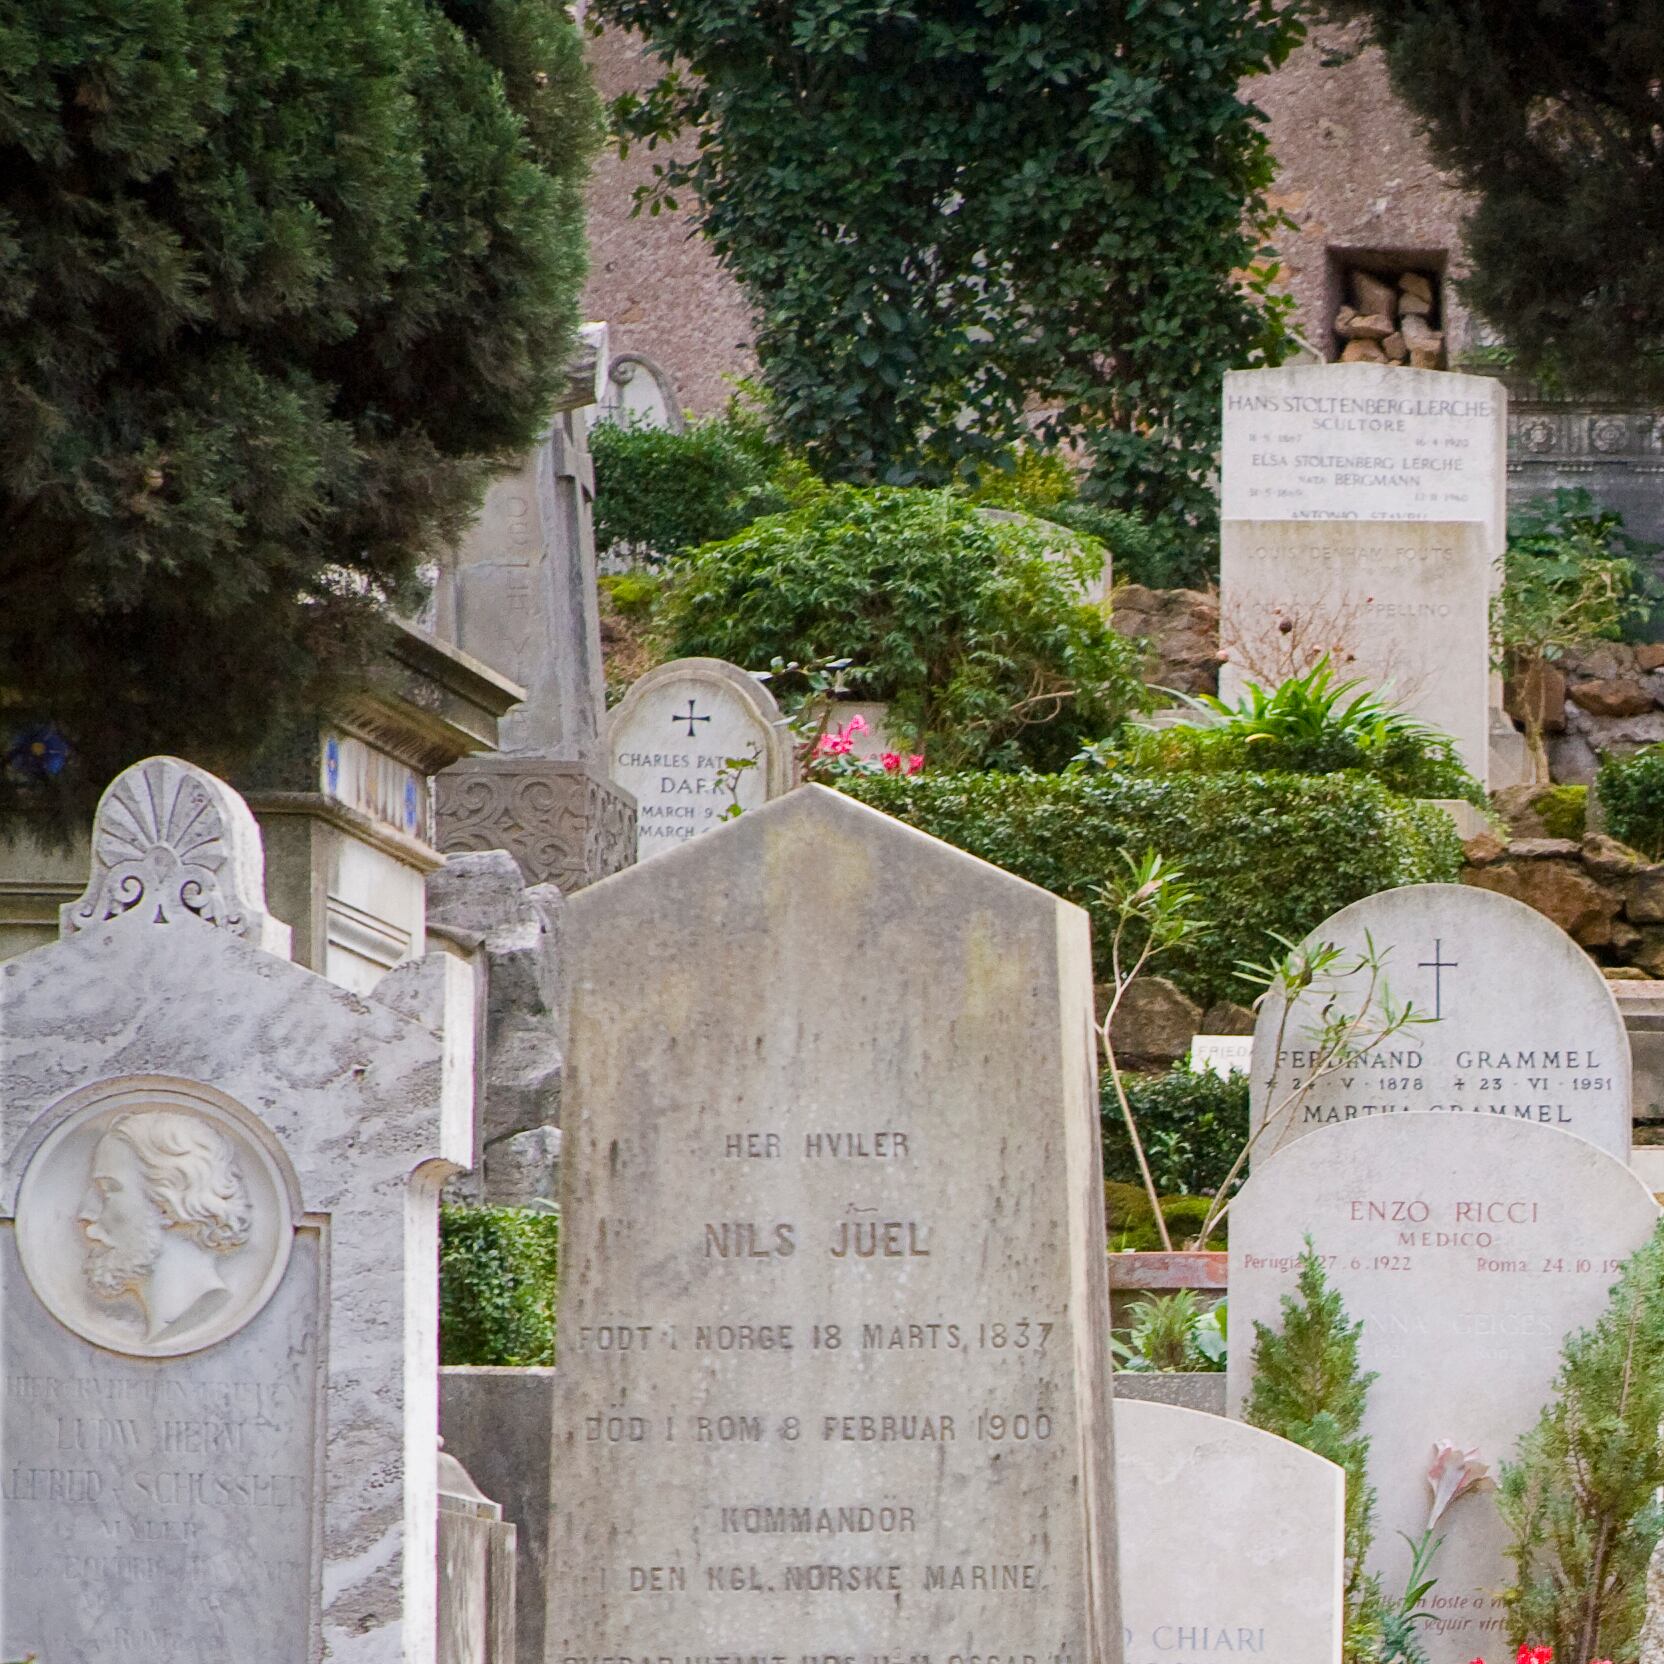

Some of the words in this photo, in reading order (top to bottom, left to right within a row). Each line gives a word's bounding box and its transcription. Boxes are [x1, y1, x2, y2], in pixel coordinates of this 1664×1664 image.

[1228, 395, 1279, 413] HANS
[1284, 396, 1414, 416] STOLTENBERG
[1416, 400, 1491, 418] LERCHE
[1313, 418, 1406, 432] SCULTORE
[1252, 454, 1288, 468] ELSA
[1294, 455, 1394, 470] STOLTENBERG
[1402, 457, 1464, 472] LERCHE
[1334, 474, 1421, 487] BERGMANN
[618, 753, 690, 768] CHARLES
[641, 806, 695, 819] MARCH
[1456, 1050, 1601, 1069] GRAMMEL
[1379, 1077, 1424, 1091] 1878
[1530, 1077, 1549, 1091] VI
[1572, 1077, 1613, 1091] 1951
[726, 1133, 781, 1158] HER
[805, 1132, 910, 1158] HVILER
[1350, 1200, 1431, 1223] ENZO
[1455, 1201, 1539, 1225] RICCI
[703, 1222, 796, 1258] NILS
[830, 1222, 931, 1258] JUEL
[1398, 1231, 1493, 1248] MEDICO
[1243, 1254, 1305, 1277] Perugia
[1477, 1255, 1528, 1273] Roma
[695, 1324, 794, 1351] NORGE
[812, 1323, 842, 1350] 18
[977, 1321, 1055, 1350] 1837
[699, 1416, 762, 1441] ROM
[782, 1415, 800, 1441] 8
[823, 1415, 956, 1441] FEBRUAR
[977, 1414, 1053, 1441] 1900
[630, 1566, 687, 1592] DEN
[785, 1564, 903, 1592] NORSKE
[1152, 1626, 1265, 1652] CHIARI
